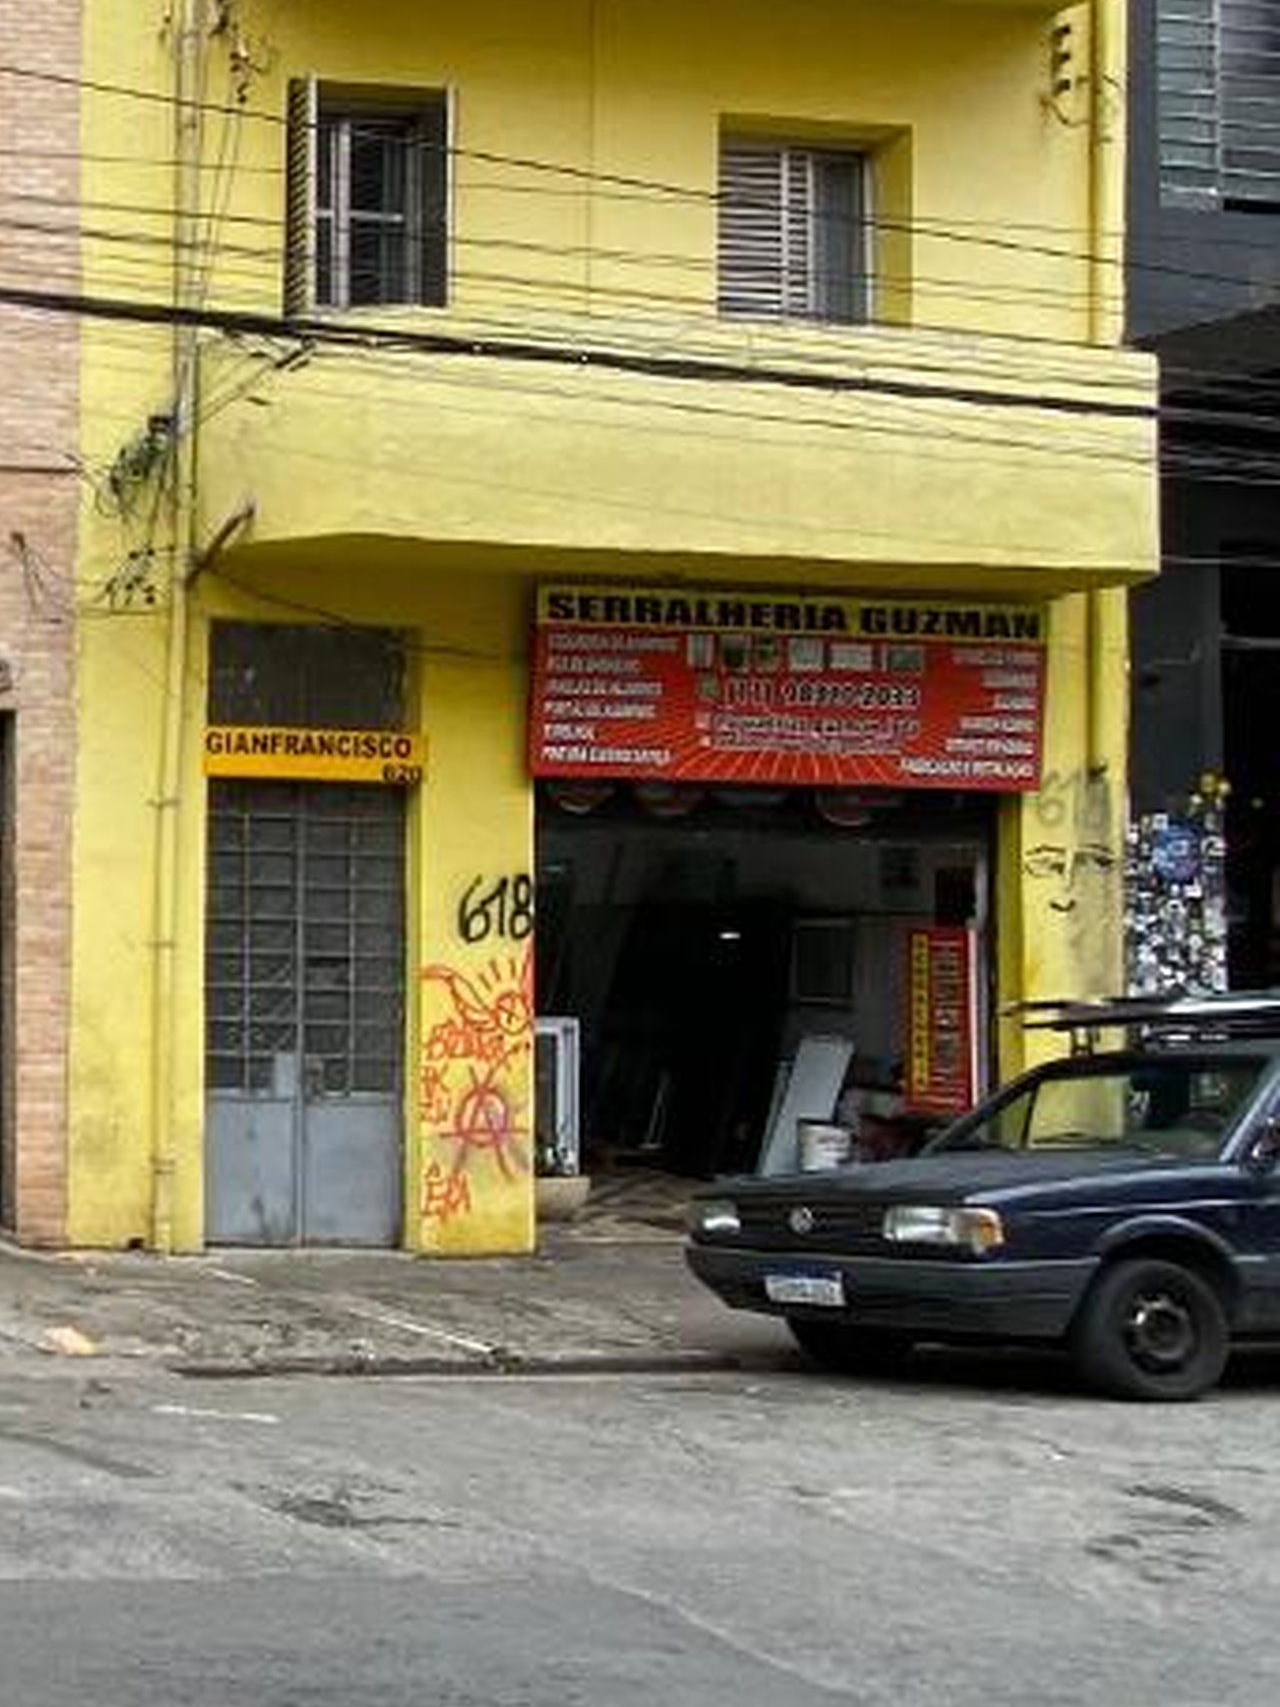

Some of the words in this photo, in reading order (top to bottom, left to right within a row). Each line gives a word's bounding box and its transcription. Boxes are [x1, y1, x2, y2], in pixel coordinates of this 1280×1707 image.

[547, 592, 847, 632] SERRALHERIA
[861, 608, 1039, 638] GUZMAN
[206, 732, 412, 758] GIANFRANCISCO
[457, 873, 531, 944] 618
